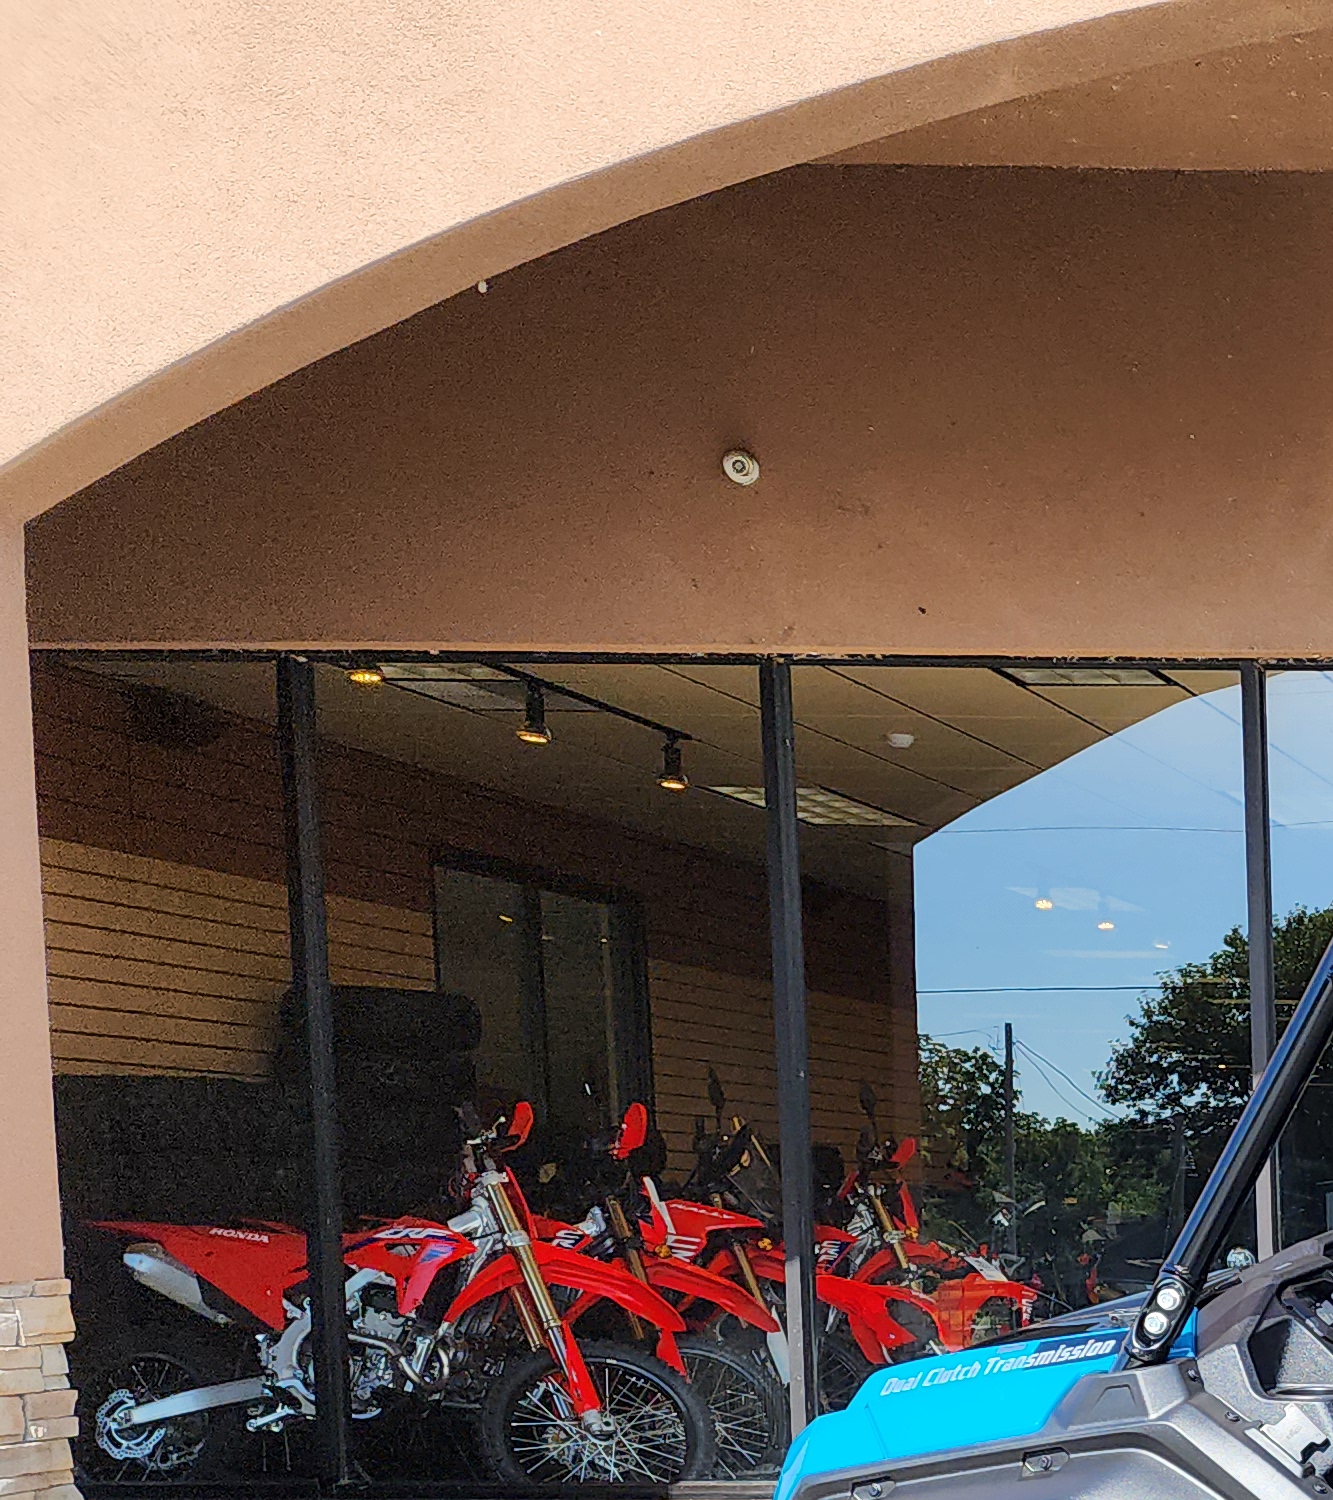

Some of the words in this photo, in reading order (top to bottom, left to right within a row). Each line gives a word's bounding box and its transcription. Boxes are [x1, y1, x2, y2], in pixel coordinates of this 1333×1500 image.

[209, 1228, 269, 1243] HONDA
[880, 1372, 922, 1396] Dual
[922, 1361, 981, 1387] Clutch
[984, 1339, 1117, 1376] Transmission
